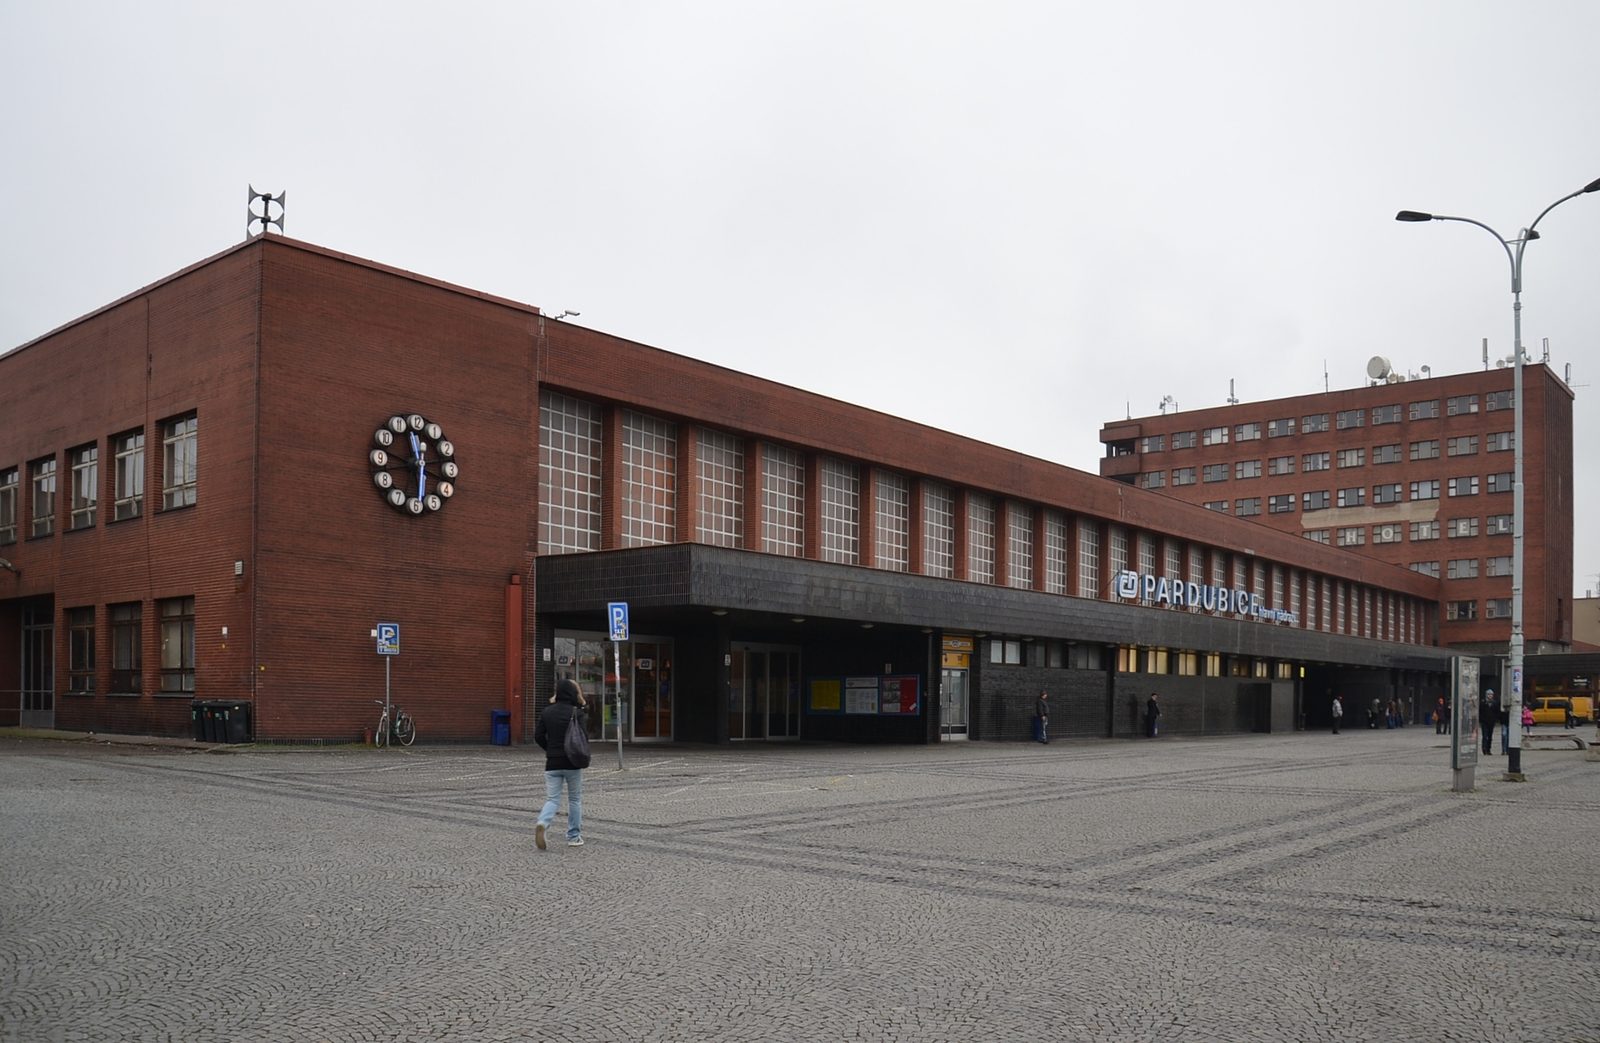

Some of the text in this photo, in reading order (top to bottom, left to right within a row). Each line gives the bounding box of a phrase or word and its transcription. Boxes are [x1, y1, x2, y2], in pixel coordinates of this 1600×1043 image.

[396, 420, 402, 431] 11
[414, 416, 420, 428] 12
[433, 427, 437, 437] 1
[382, 432, 389, 444] 10
[444, 443, 450, 455] 2
[378, 452, 383, 463] 9
[449, 465, 454, 476] 3
[382, 474, 388, 486] 8
[443, 484, 449, 495] 4
[395, 492, 402, 504] 7
[432, 497, 437, 508] 5
[413, 500, 419, 511] 6
[1143, 574, 1259, 616] PARDUBICE
[613, 608, 624, 630] P
